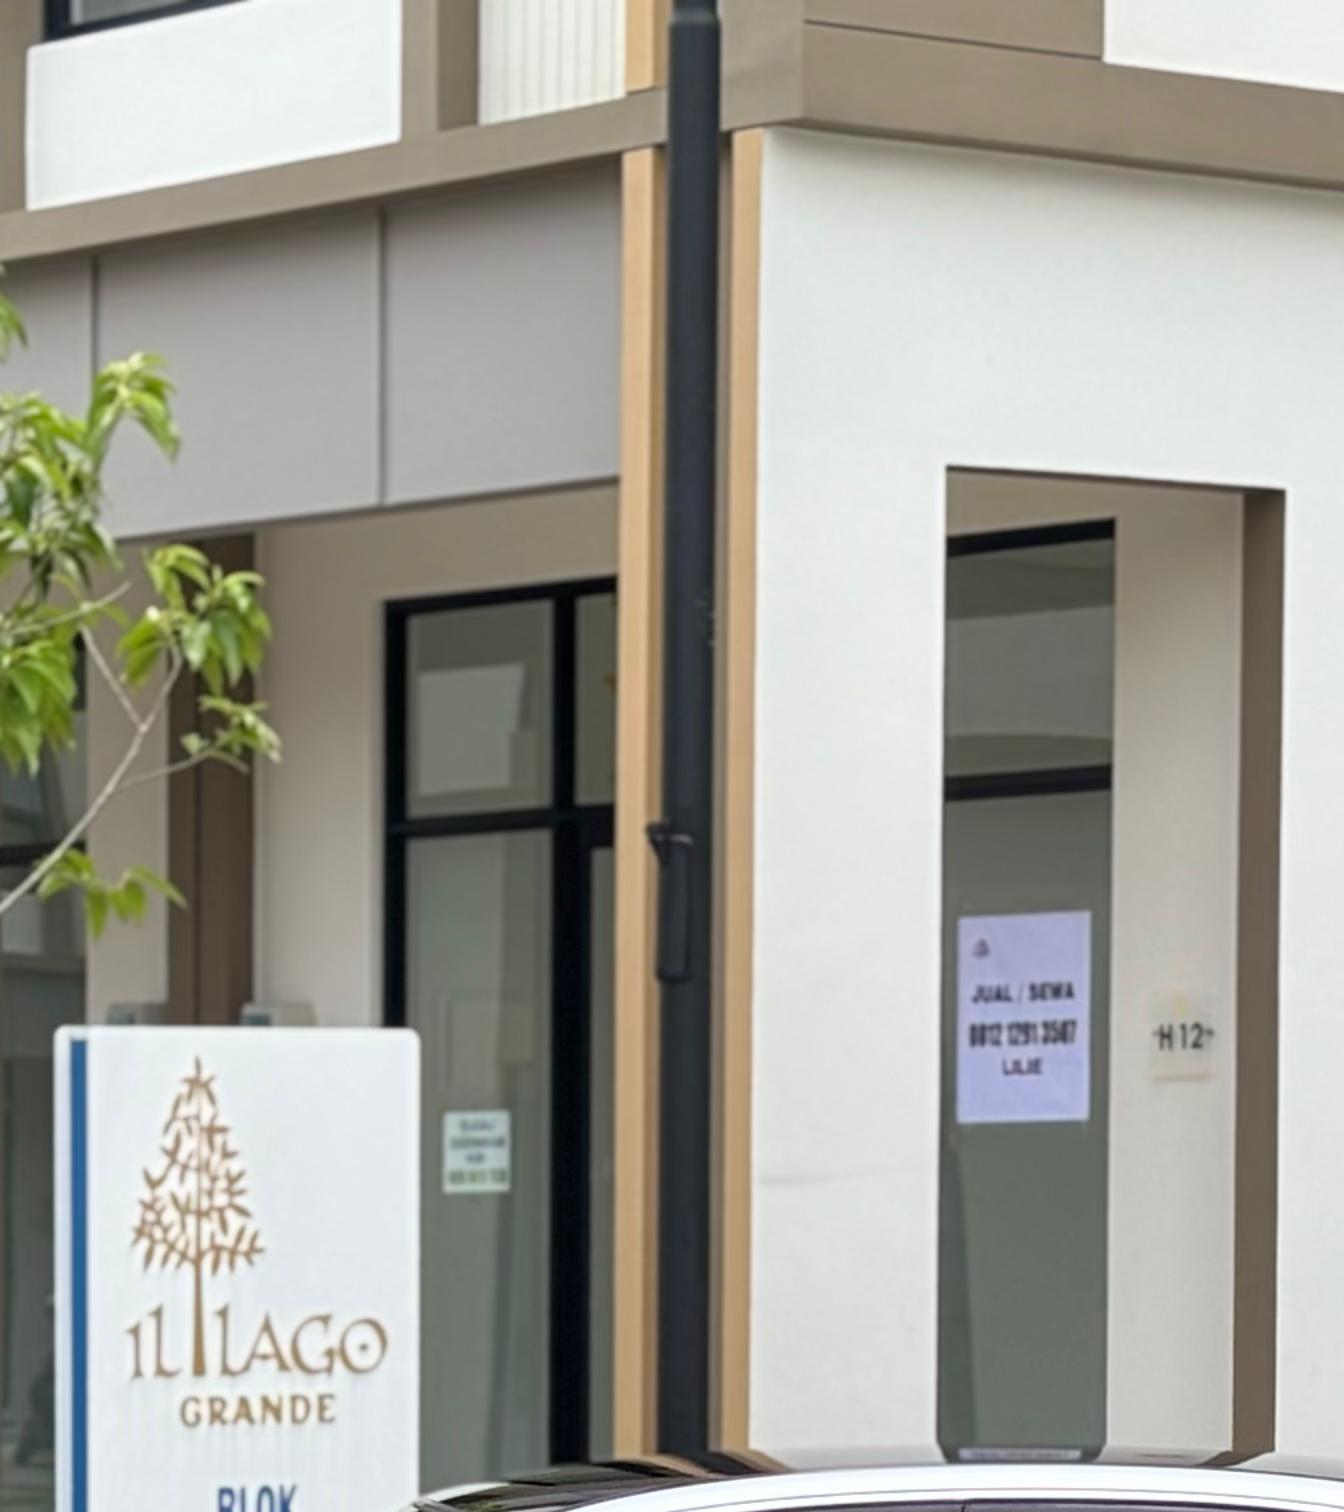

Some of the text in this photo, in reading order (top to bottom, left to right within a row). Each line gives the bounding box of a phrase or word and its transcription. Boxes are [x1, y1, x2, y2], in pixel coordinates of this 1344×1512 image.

[972, 984, 1013, 1004] JUAL
[1029, 981, 1074, 1002] SEWA
[1158, 1021, 1204, 1052] H 12
[213, 1303, 388, 1378] LAGO
[179, 1393, 336, 1428] GRANDE
